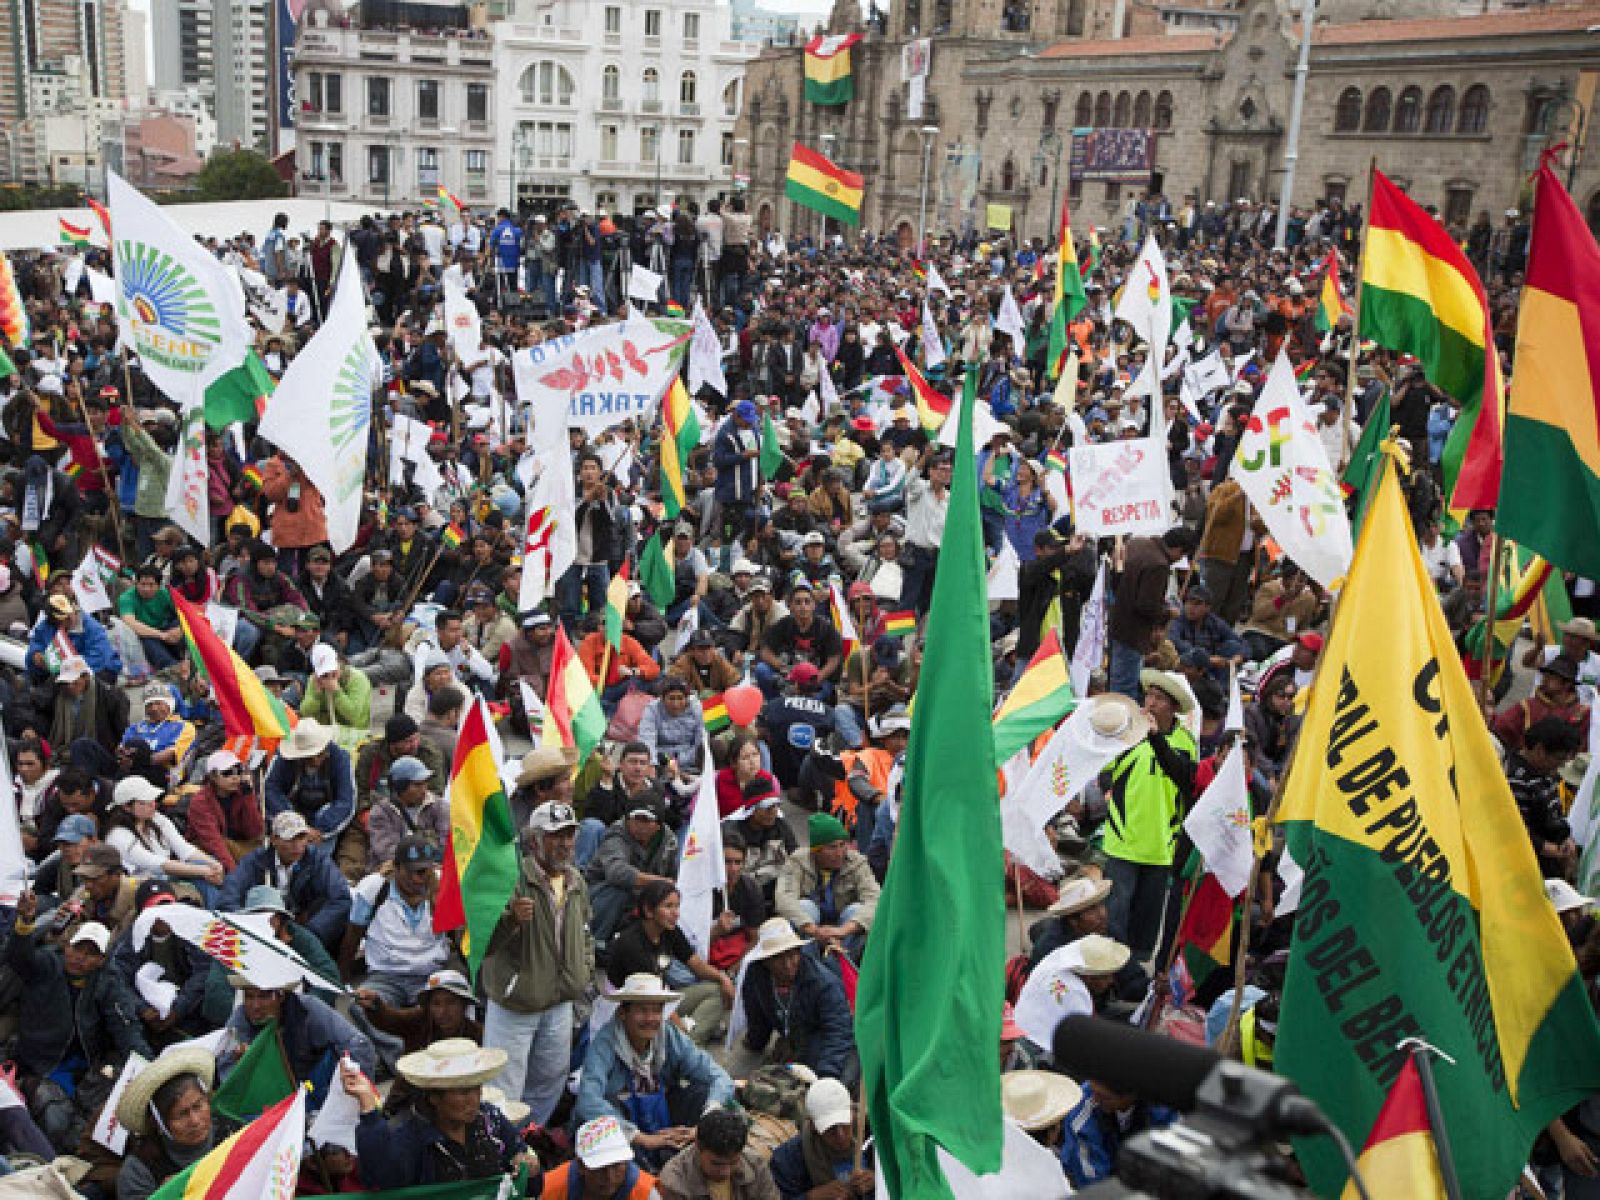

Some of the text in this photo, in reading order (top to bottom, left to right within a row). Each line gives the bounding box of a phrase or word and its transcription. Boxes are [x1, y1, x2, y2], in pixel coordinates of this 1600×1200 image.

[1337, 746, 1410, 818] DE
[1365, 794, 1467, 963] PUEBLOS
[1305, 924, 1381, 1015] DEL
